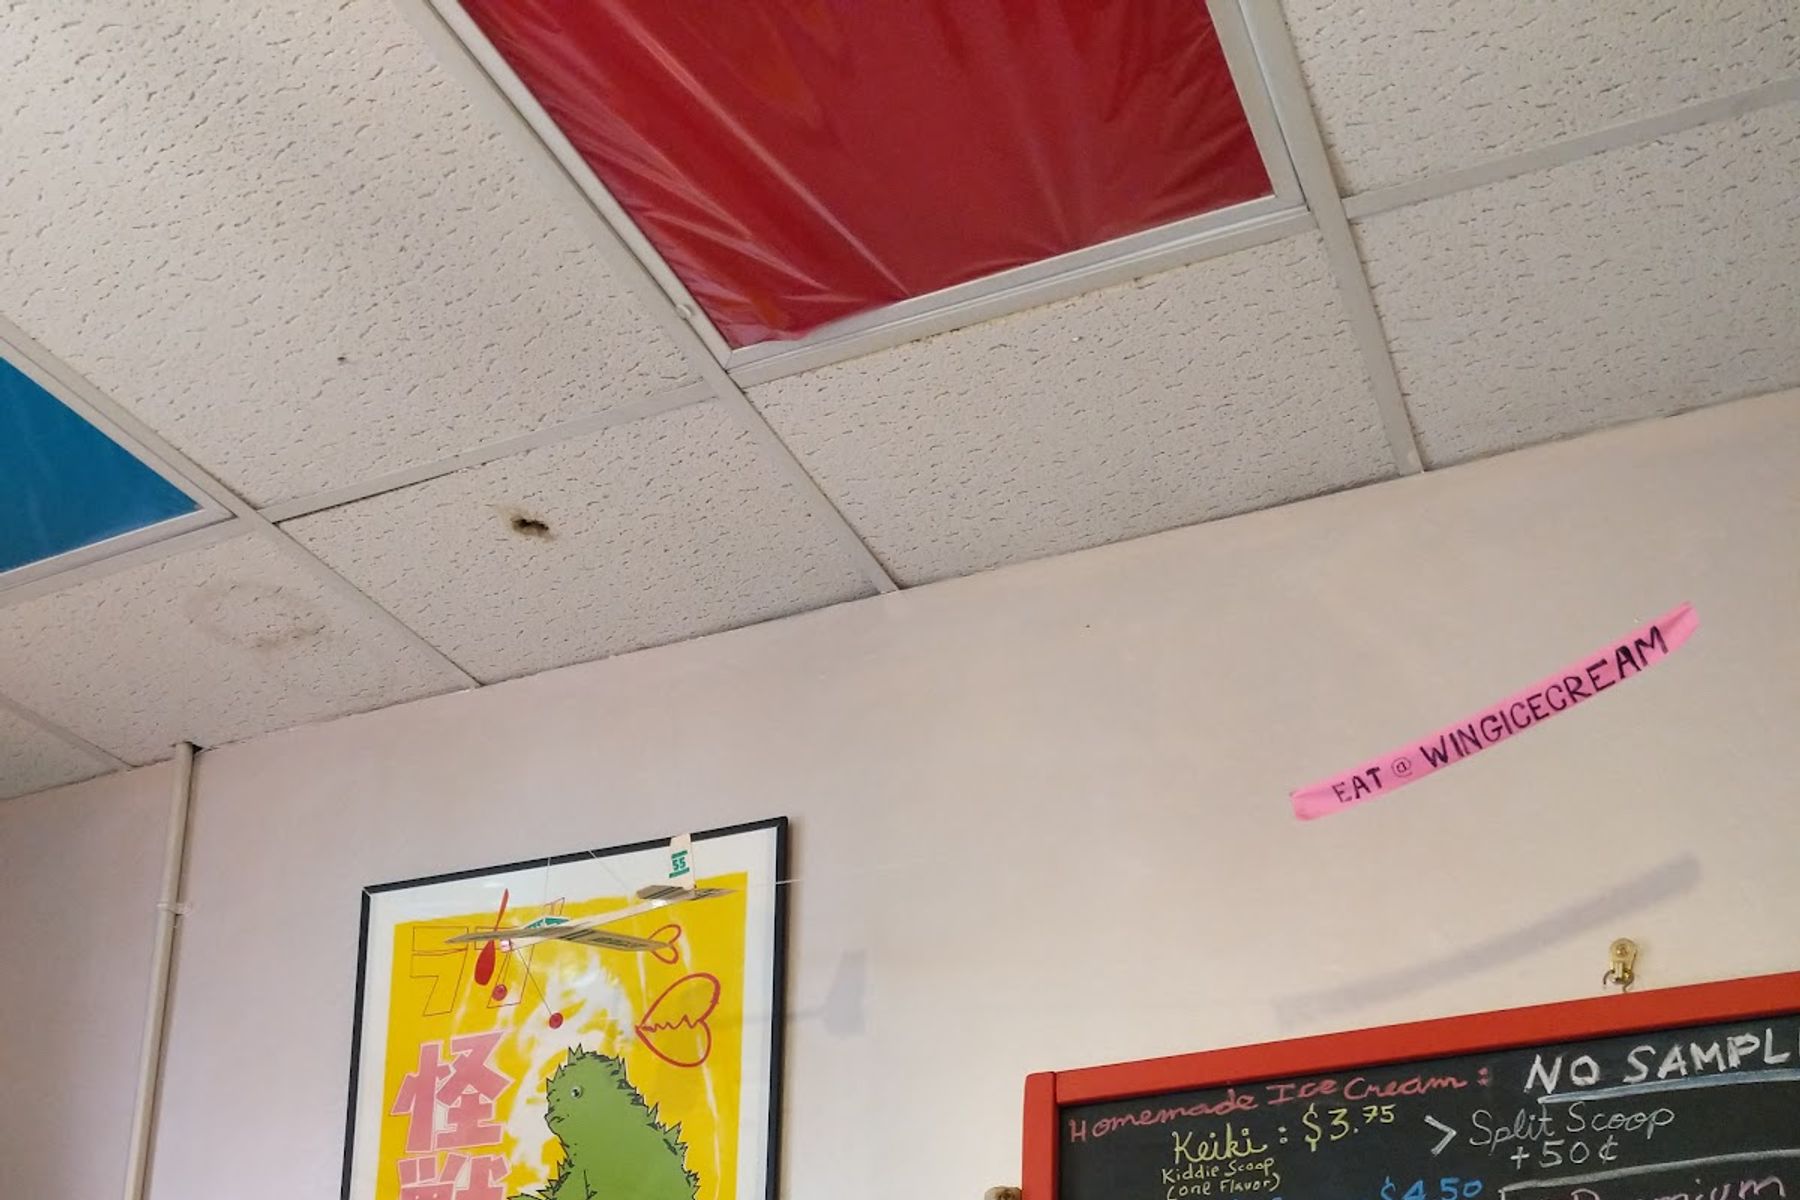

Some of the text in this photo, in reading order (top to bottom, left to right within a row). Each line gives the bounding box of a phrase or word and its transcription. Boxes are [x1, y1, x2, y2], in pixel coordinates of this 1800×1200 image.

[1331, 625, 1669, 803] EAT @ WINGICECREAM
[671, 857, 689, 872] 55
[1523, 1028, 1800, 1096] NO SAMPL
[1069, 1088, 1258, 1142] Homemade
[1266, 1078, 1337, 1105] Ice
[1469, 1101, 1676, 1155] Split Scoop
[1161, 1157, 1275, 1186] Kiddie Scoop
[1219, 1172, 1282, 1194] Flavor)
